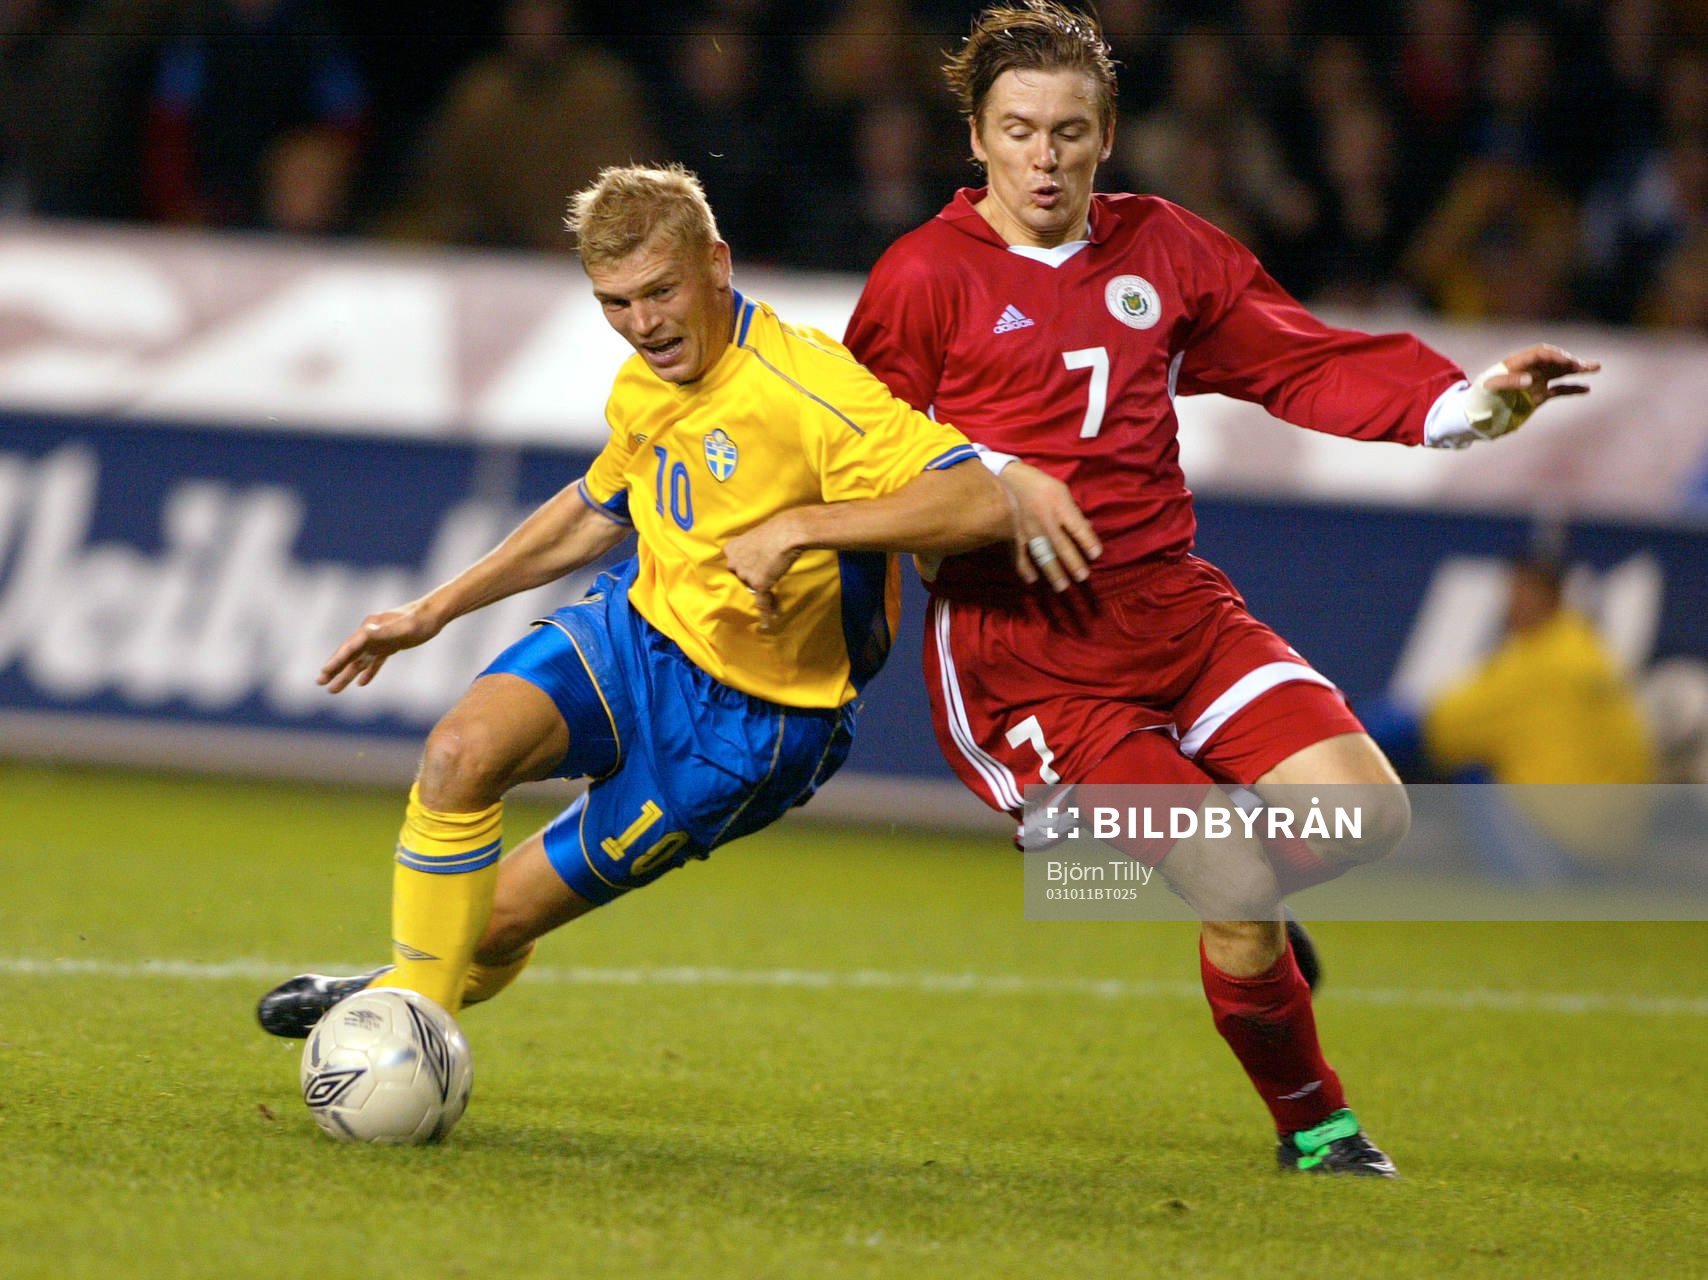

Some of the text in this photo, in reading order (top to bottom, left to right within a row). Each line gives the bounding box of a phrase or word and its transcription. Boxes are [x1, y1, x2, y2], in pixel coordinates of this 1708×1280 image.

[1062, 346, 1110, 439] 7
[653, 445, 694, 532] 10
[1004, 714, 1061, 786] 7
[600, 799, 690, 877] 10
